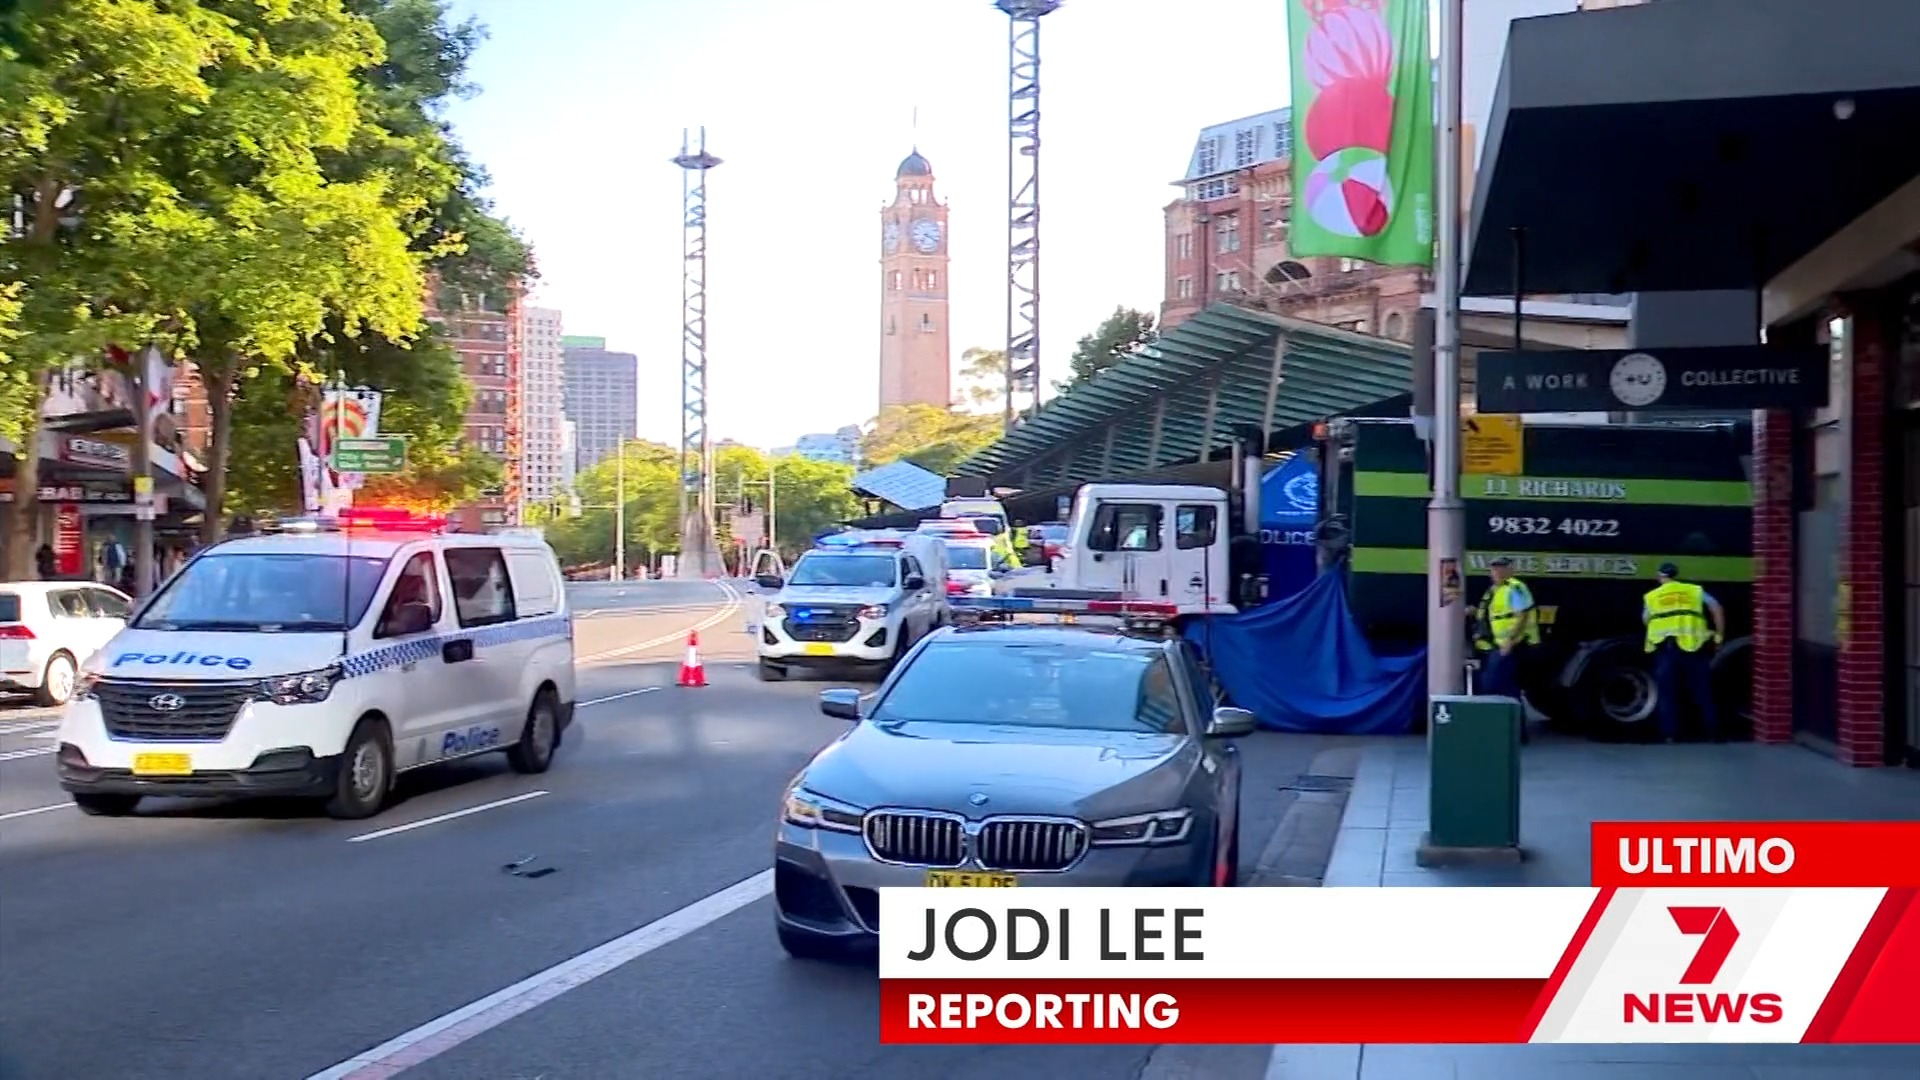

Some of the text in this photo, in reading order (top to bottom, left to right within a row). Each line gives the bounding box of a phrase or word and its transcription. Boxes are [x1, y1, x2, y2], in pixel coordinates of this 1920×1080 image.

[1503, 373, 1589, 390] A WORK
[1680, 368, 1800, 386] COLLECTIVE
[1518, 479, 1626, 499] RICHARDS
[1488, 516, 1621, 537] 9832 4022
[1469, 555, 1638, 576] WTE SERVICES
[112, 651, 252, 670] Police
[442, 726, 500, 755] Police
